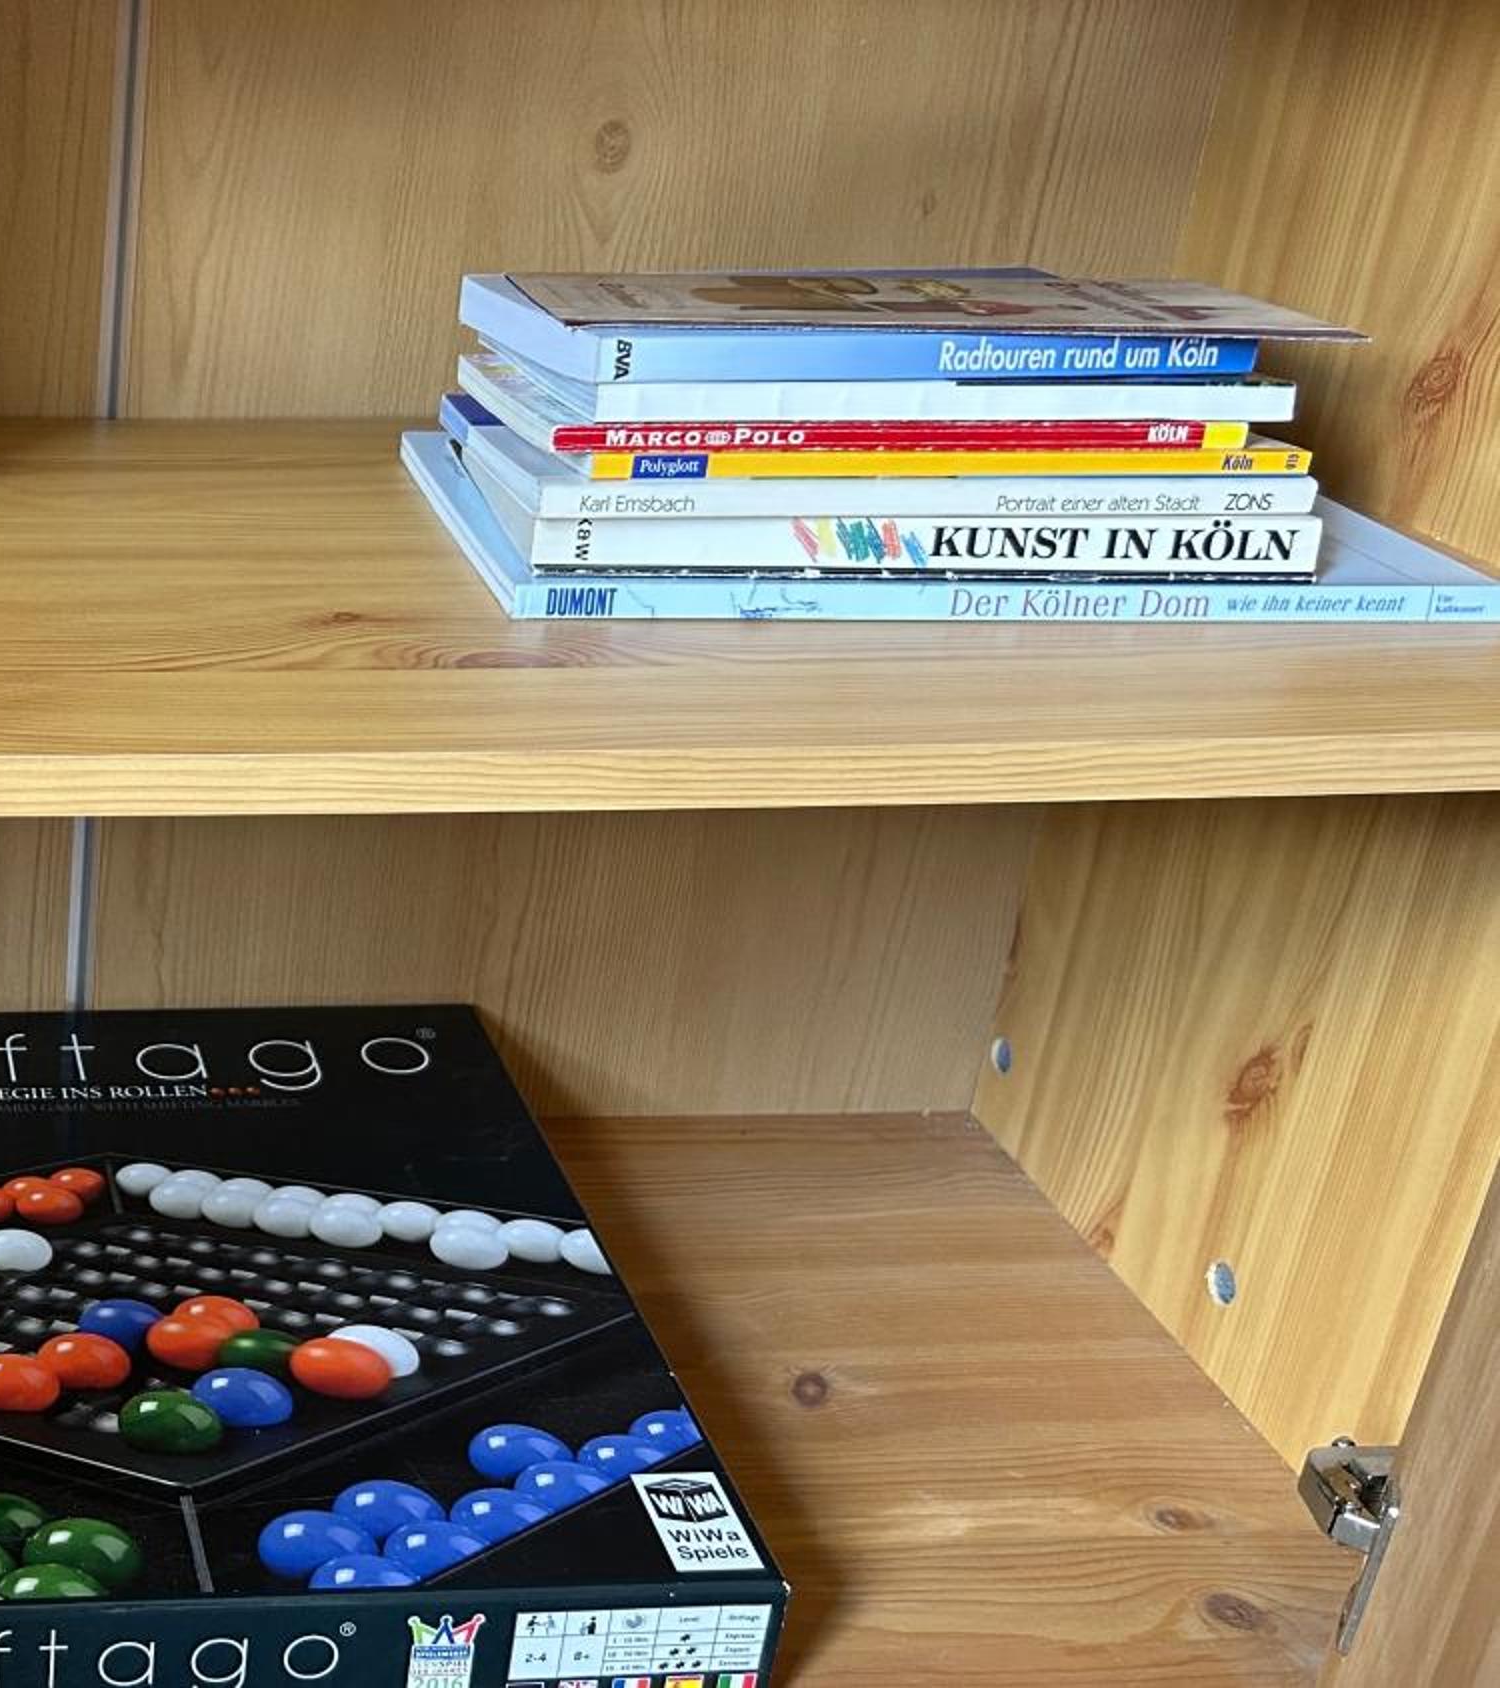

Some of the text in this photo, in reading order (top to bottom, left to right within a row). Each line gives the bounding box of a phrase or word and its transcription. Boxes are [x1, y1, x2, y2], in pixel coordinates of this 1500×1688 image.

[612, 338, 633, 382] BVA
[938, 335, 1220, 371] Radtouren rund um Köln
[604, 428, 806, 447] MARCO POLO
[1146, 421, 1190, 443] KÖLN
[639, 454, 700, 477] Polyglott
[1220, 453, 1254, 471] Köln
[579, 495, 696, 513] Karl Emsbach
[995, 493, 1201, 512] Portrait einer alten Stadt
[1223, 492, 1275, 511] ZONS
[928, 519, 1302, 561] KUNST IN KÖLN
[546, 587, 618, 617] DUMONT
[950, 588, 1407, 618] Der Kölner Dom wie ihn keiner kennt
[61, 1087, 102, 1100] INS
[667, 1527, 742, 1544] WiWa
[676, 1545, 750, 1562] Spiele
